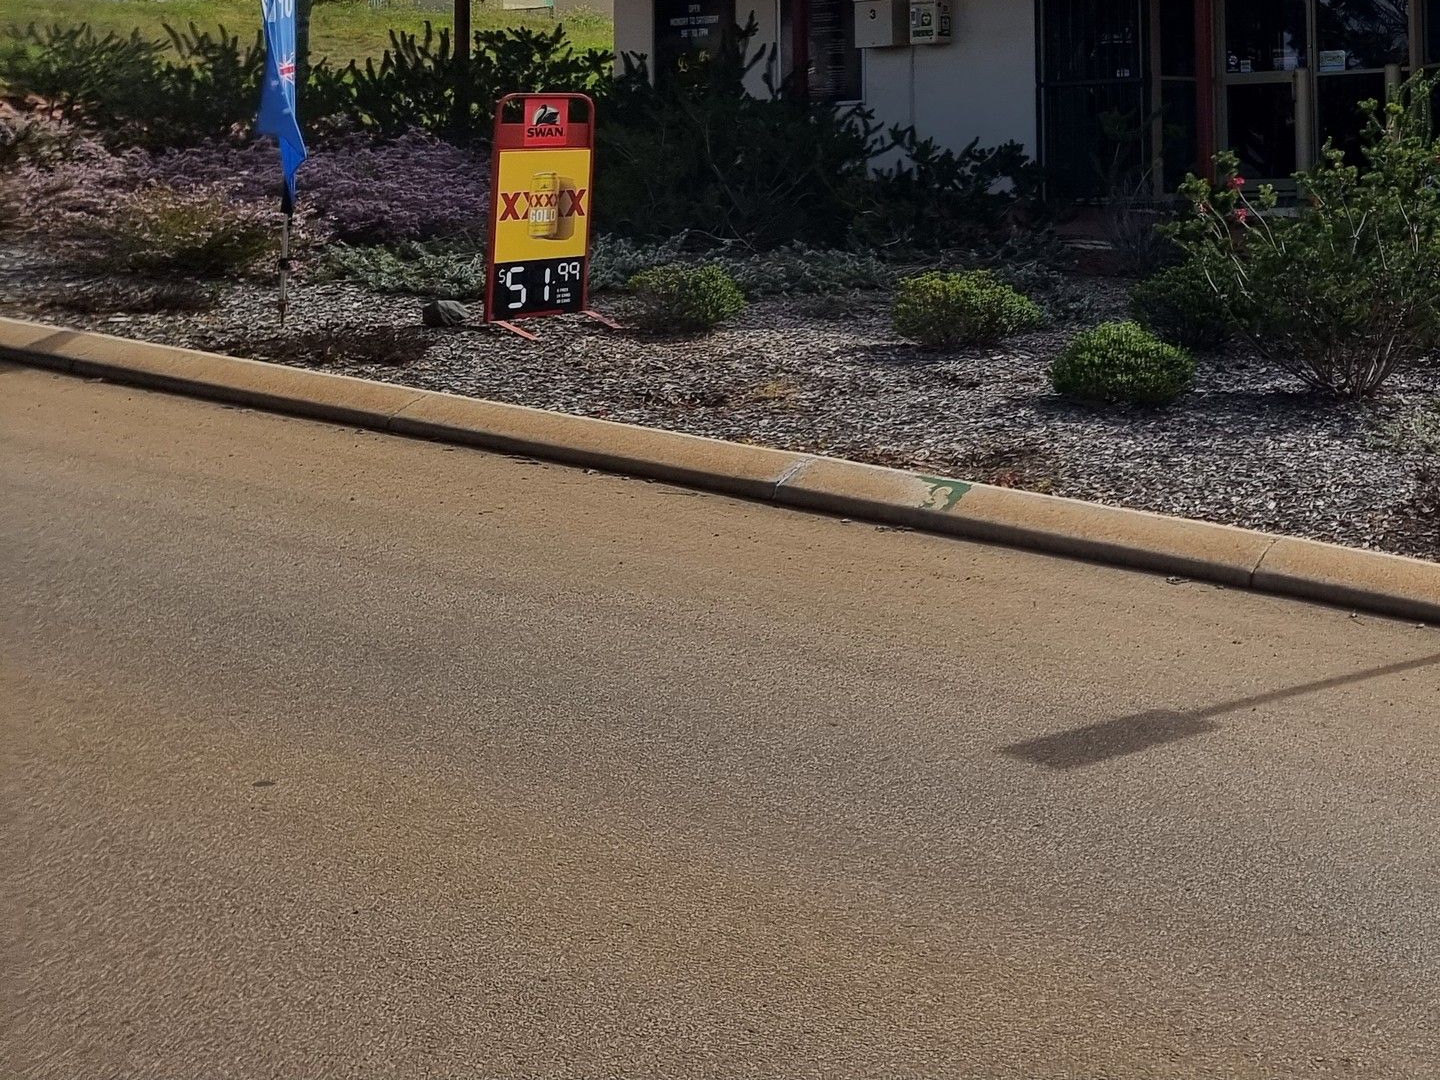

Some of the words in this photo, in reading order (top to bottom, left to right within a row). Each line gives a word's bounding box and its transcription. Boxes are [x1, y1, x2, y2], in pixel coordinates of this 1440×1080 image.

[869, 8, 877, 20] 3
[526, 126, 564, 139] SWAN
[530, 208, 557, 223] GOLD
